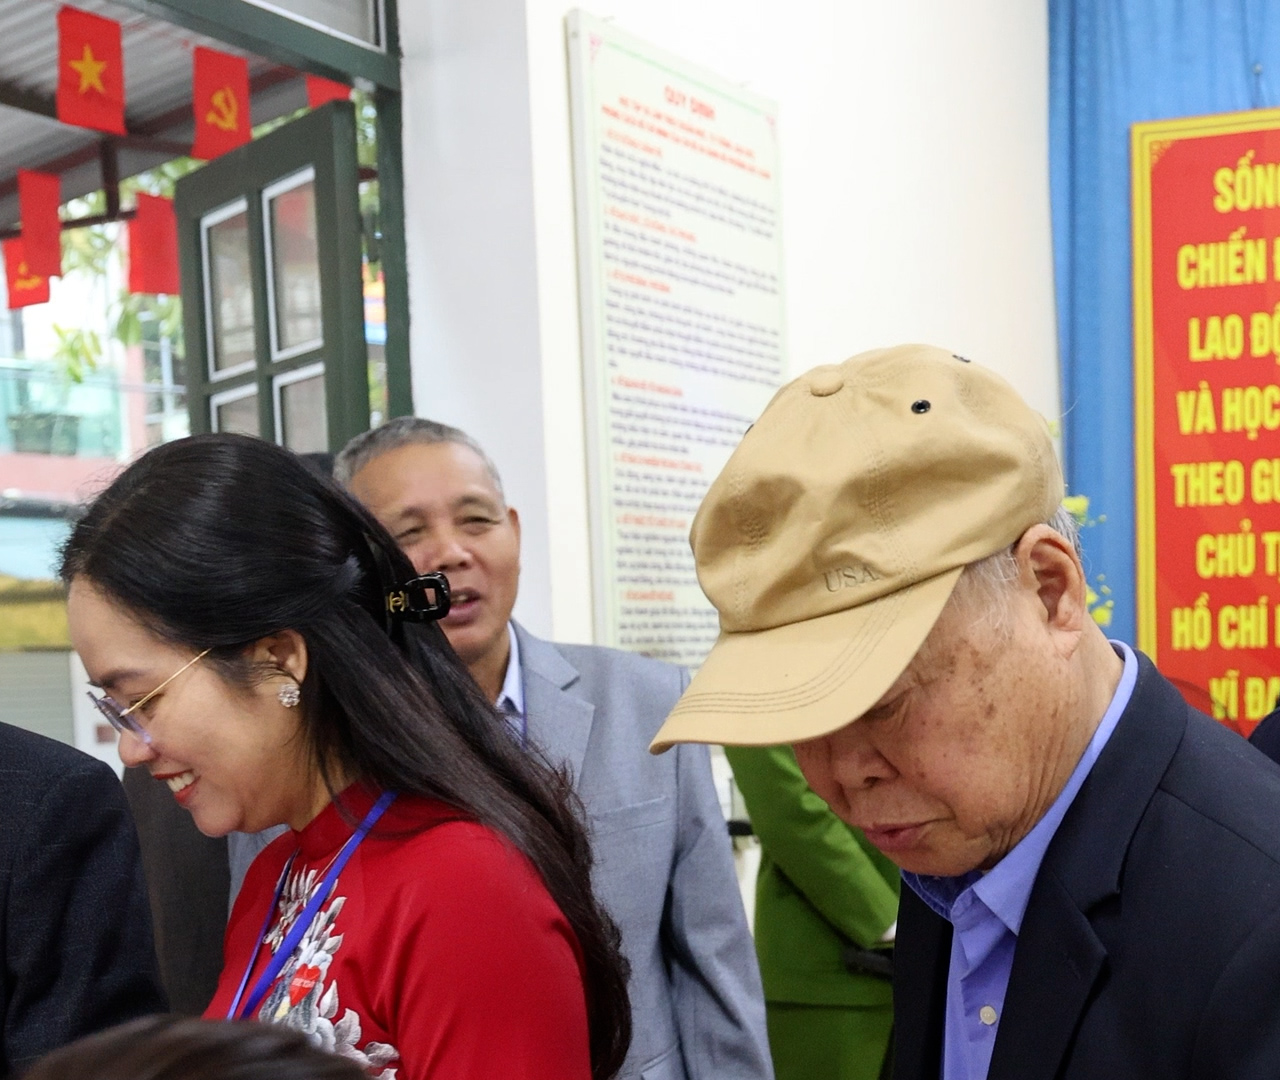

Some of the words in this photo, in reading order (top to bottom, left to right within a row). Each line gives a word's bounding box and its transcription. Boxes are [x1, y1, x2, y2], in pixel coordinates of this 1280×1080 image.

[1177, 226, 1267, 289] CHIẾN
[1189, 314, 1244, 361] LAO
[1176, 381, 1216, 435] VÀ
[1171, 460, 1244, 507] THEO
[1196, 519, 1255, 578] CHỦ
[823, 564, 880, 592] USA
[1172, 593, 1211, 650] HỒ
[1219, 596, 1267, 649] CHÍ
[1210, 670, 1238, 719] VĨ
